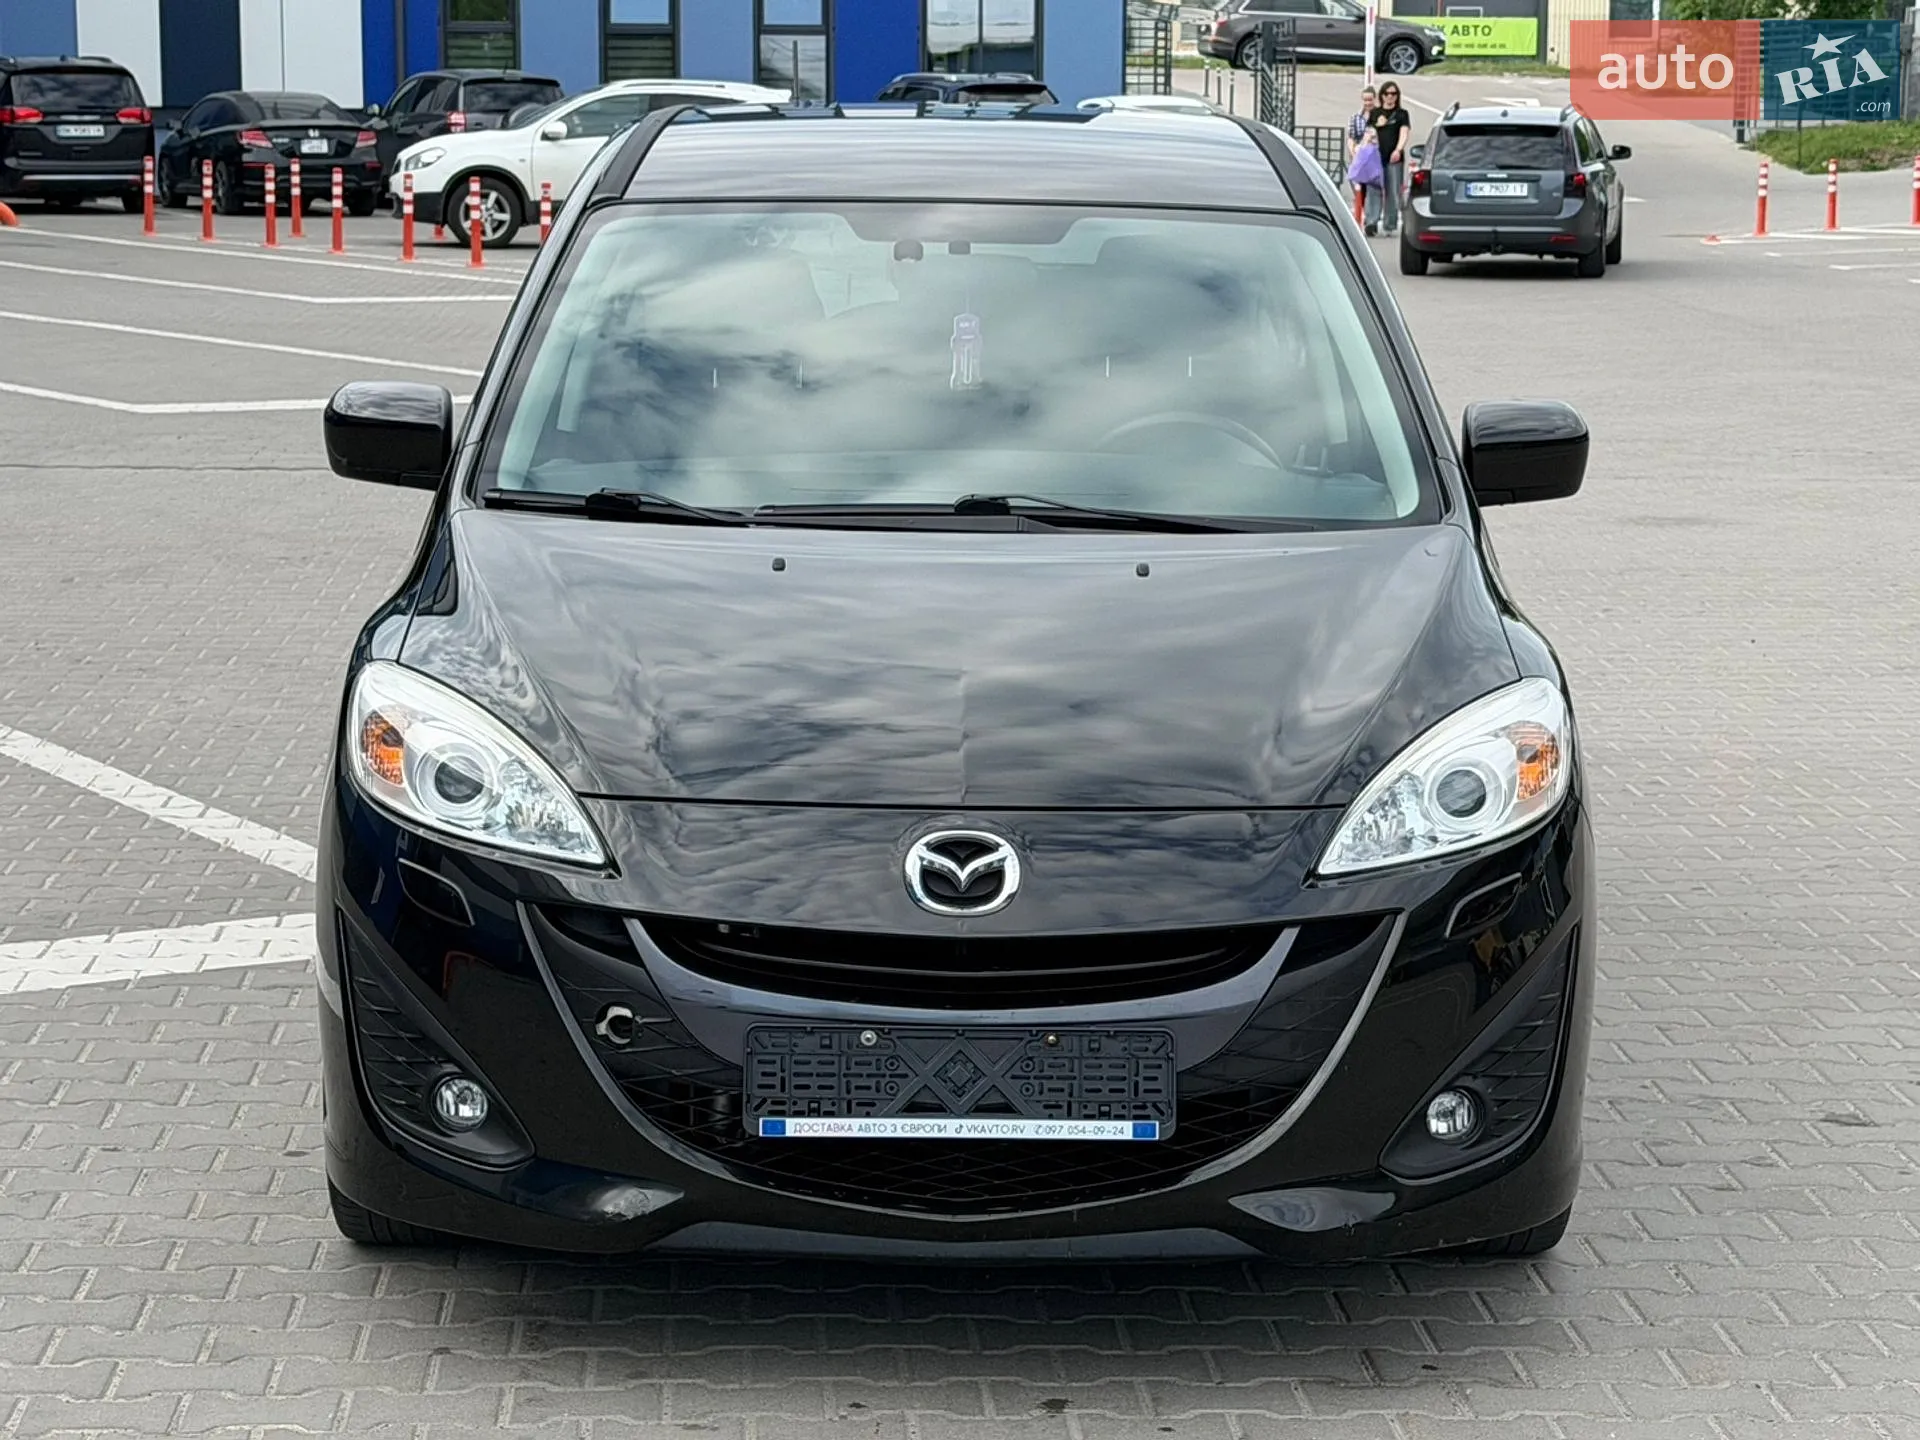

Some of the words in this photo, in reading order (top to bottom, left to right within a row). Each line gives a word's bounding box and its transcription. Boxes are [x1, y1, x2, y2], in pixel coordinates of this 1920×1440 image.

[1451, 24, 1492, 36] АВТО
[794, 1122, 854, 1134] ДОСТАВКА
[857, 1123, 888, 1134] АВТО
[901, 1123, 947, 1134] ЄВРОПИ
[1044, 1124, 1064, 1135] 097
[1067, 1125, 1125, 1135] 054-09-24
